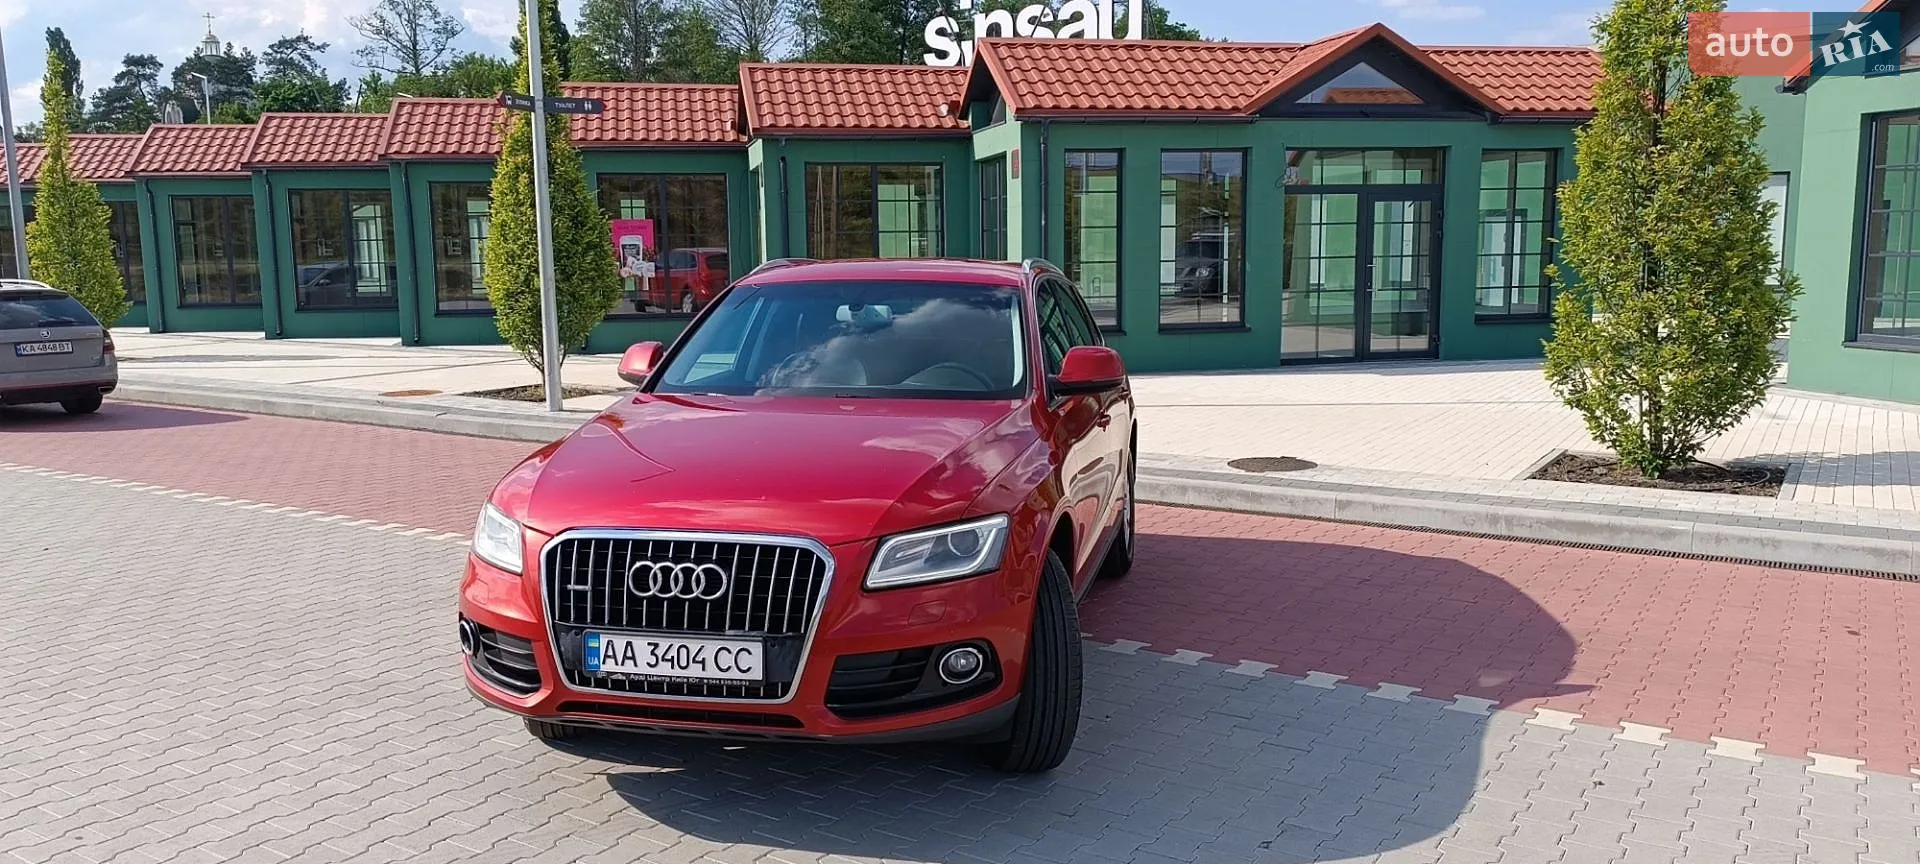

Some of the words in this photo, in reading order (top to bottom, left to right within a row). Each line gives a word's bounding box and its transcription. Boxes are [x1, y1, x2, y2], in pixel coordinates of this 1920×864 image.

[587, 656, 599, 666] UA
[602, 639, 638, 668] AA
[645, 641, 706, 672] 3404
[713, 646, 753, 674] CC
